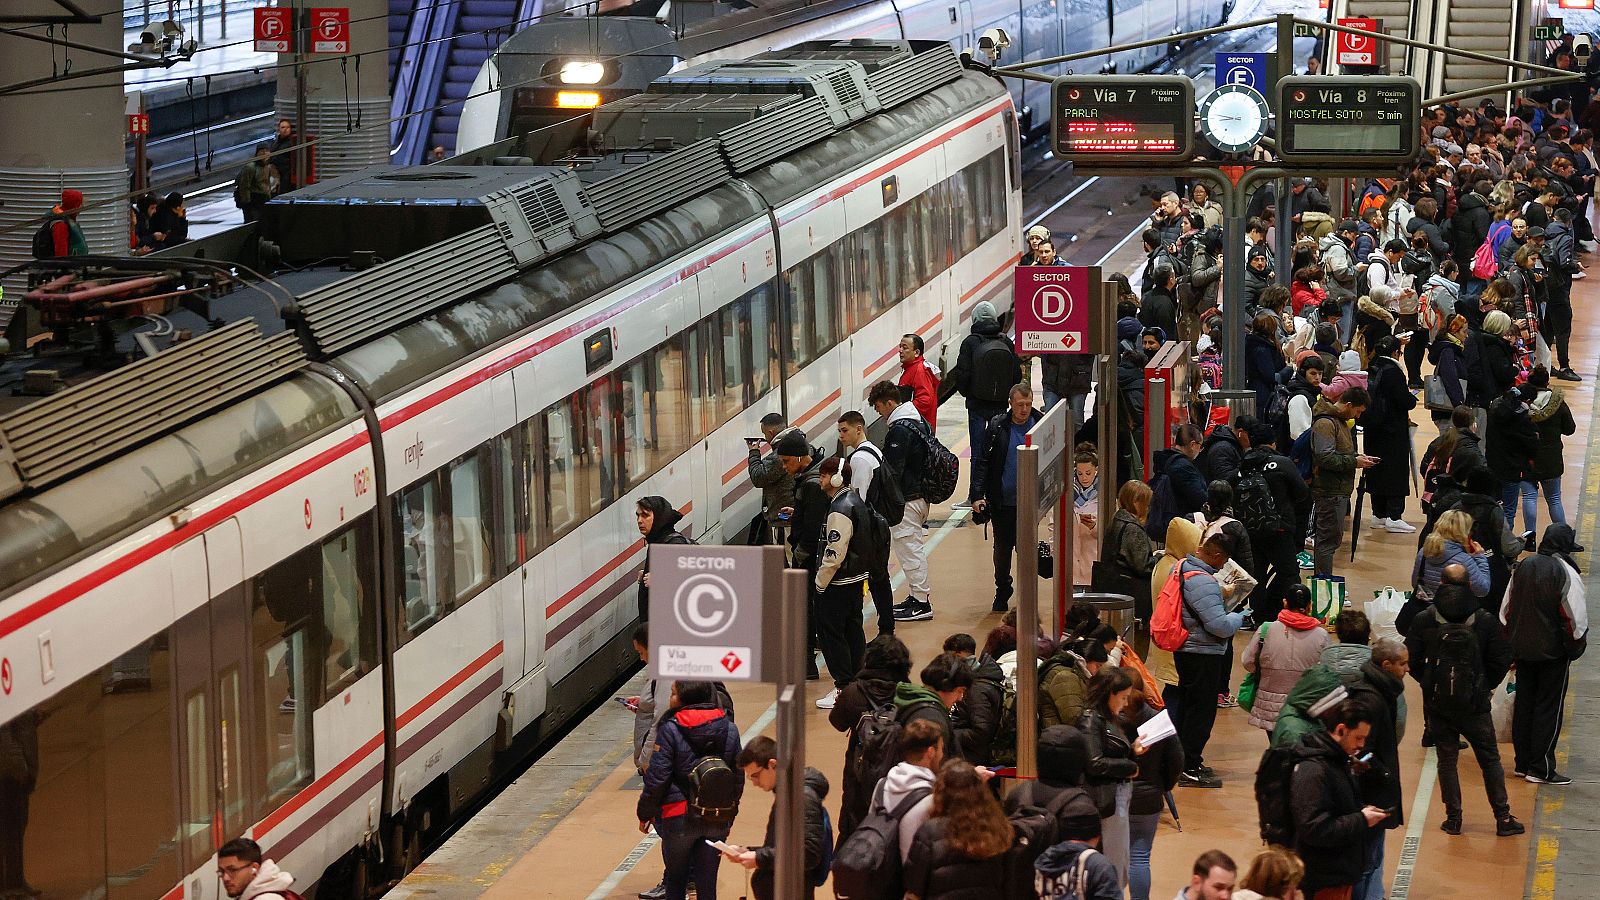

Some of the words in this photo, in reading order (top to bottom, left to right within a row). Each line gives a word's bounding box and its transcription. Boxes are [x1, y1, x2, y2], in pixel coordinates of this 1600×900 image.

[267, 20, 278, 35] F
[325, 21, 336, 36] F
[1093, 88, 1117, 102] Vía
[1127, 90, 1137, 102] 7
[1151, 88, 1180, 96] Próximo
[1318, 89, 1342, 103] Vía
[1357, 90, 1367, 103] 8
[1064, 108, 1098, 118] PARLA
[1335, 110, 1363, 119] SOTO
[1377, 110, 1385, 120] 5
[1387, 110, 1403, 120] min
[1033, 273, 1071, 282] SECTOR
[1042, 291, 1065, 318] D
[1027, 341, 1058, 350] Platform
[1065, 336, 1072, 345] 7
[404, 431, 424, 470] renfe
[677, 556, 736, 570] SECTOR
[687, 583, 725, 628] C
[667, 660, 714, 676] Platform
[726, 654, 736, 668] 7
